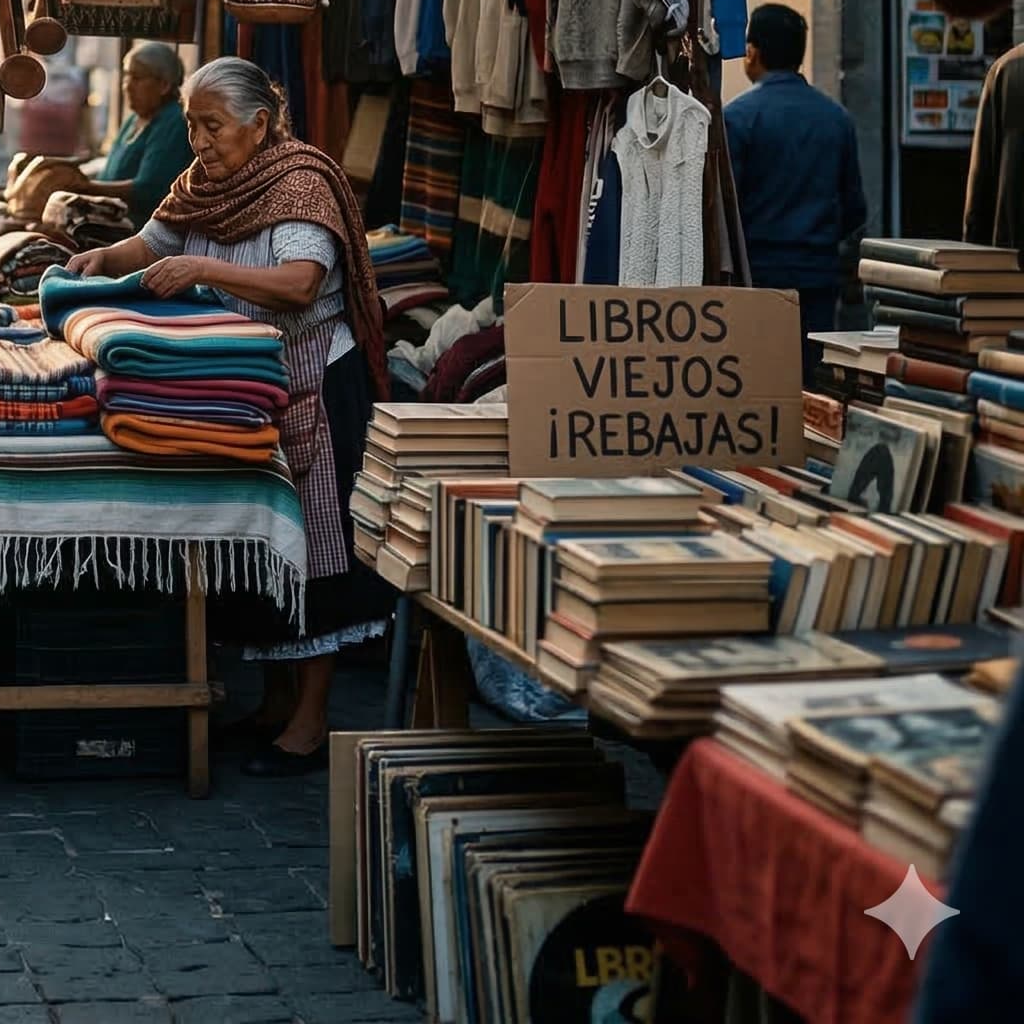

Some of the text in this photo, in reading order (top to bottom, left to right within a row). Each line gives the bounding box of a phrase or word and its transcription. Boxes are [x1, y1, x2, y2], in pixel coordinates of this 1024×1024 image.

[559, 298, 728, 344] LIBROS
[572, 354, 744, 399] VIEJOS
[548, 405, 780, 459] ¡REBAJAS!
